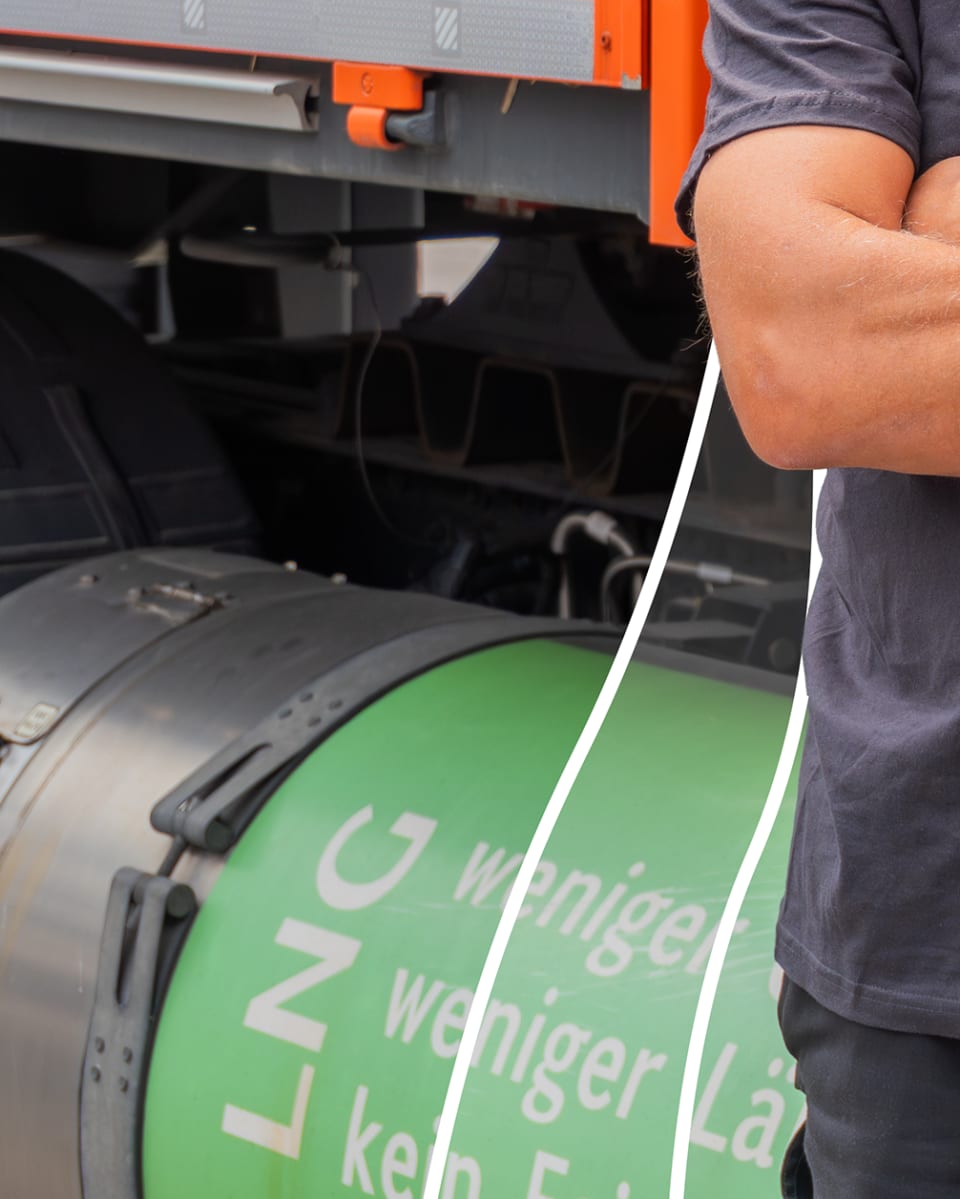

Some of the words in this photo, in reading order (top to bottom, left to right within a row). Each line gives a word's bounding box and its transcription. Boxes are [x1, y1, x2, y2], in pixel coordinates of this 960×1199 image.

[221, 804, 438, 1159] LNG
[385, 967, 669, 1125] weniger
[689, 1042, 807, 1169] Lä
